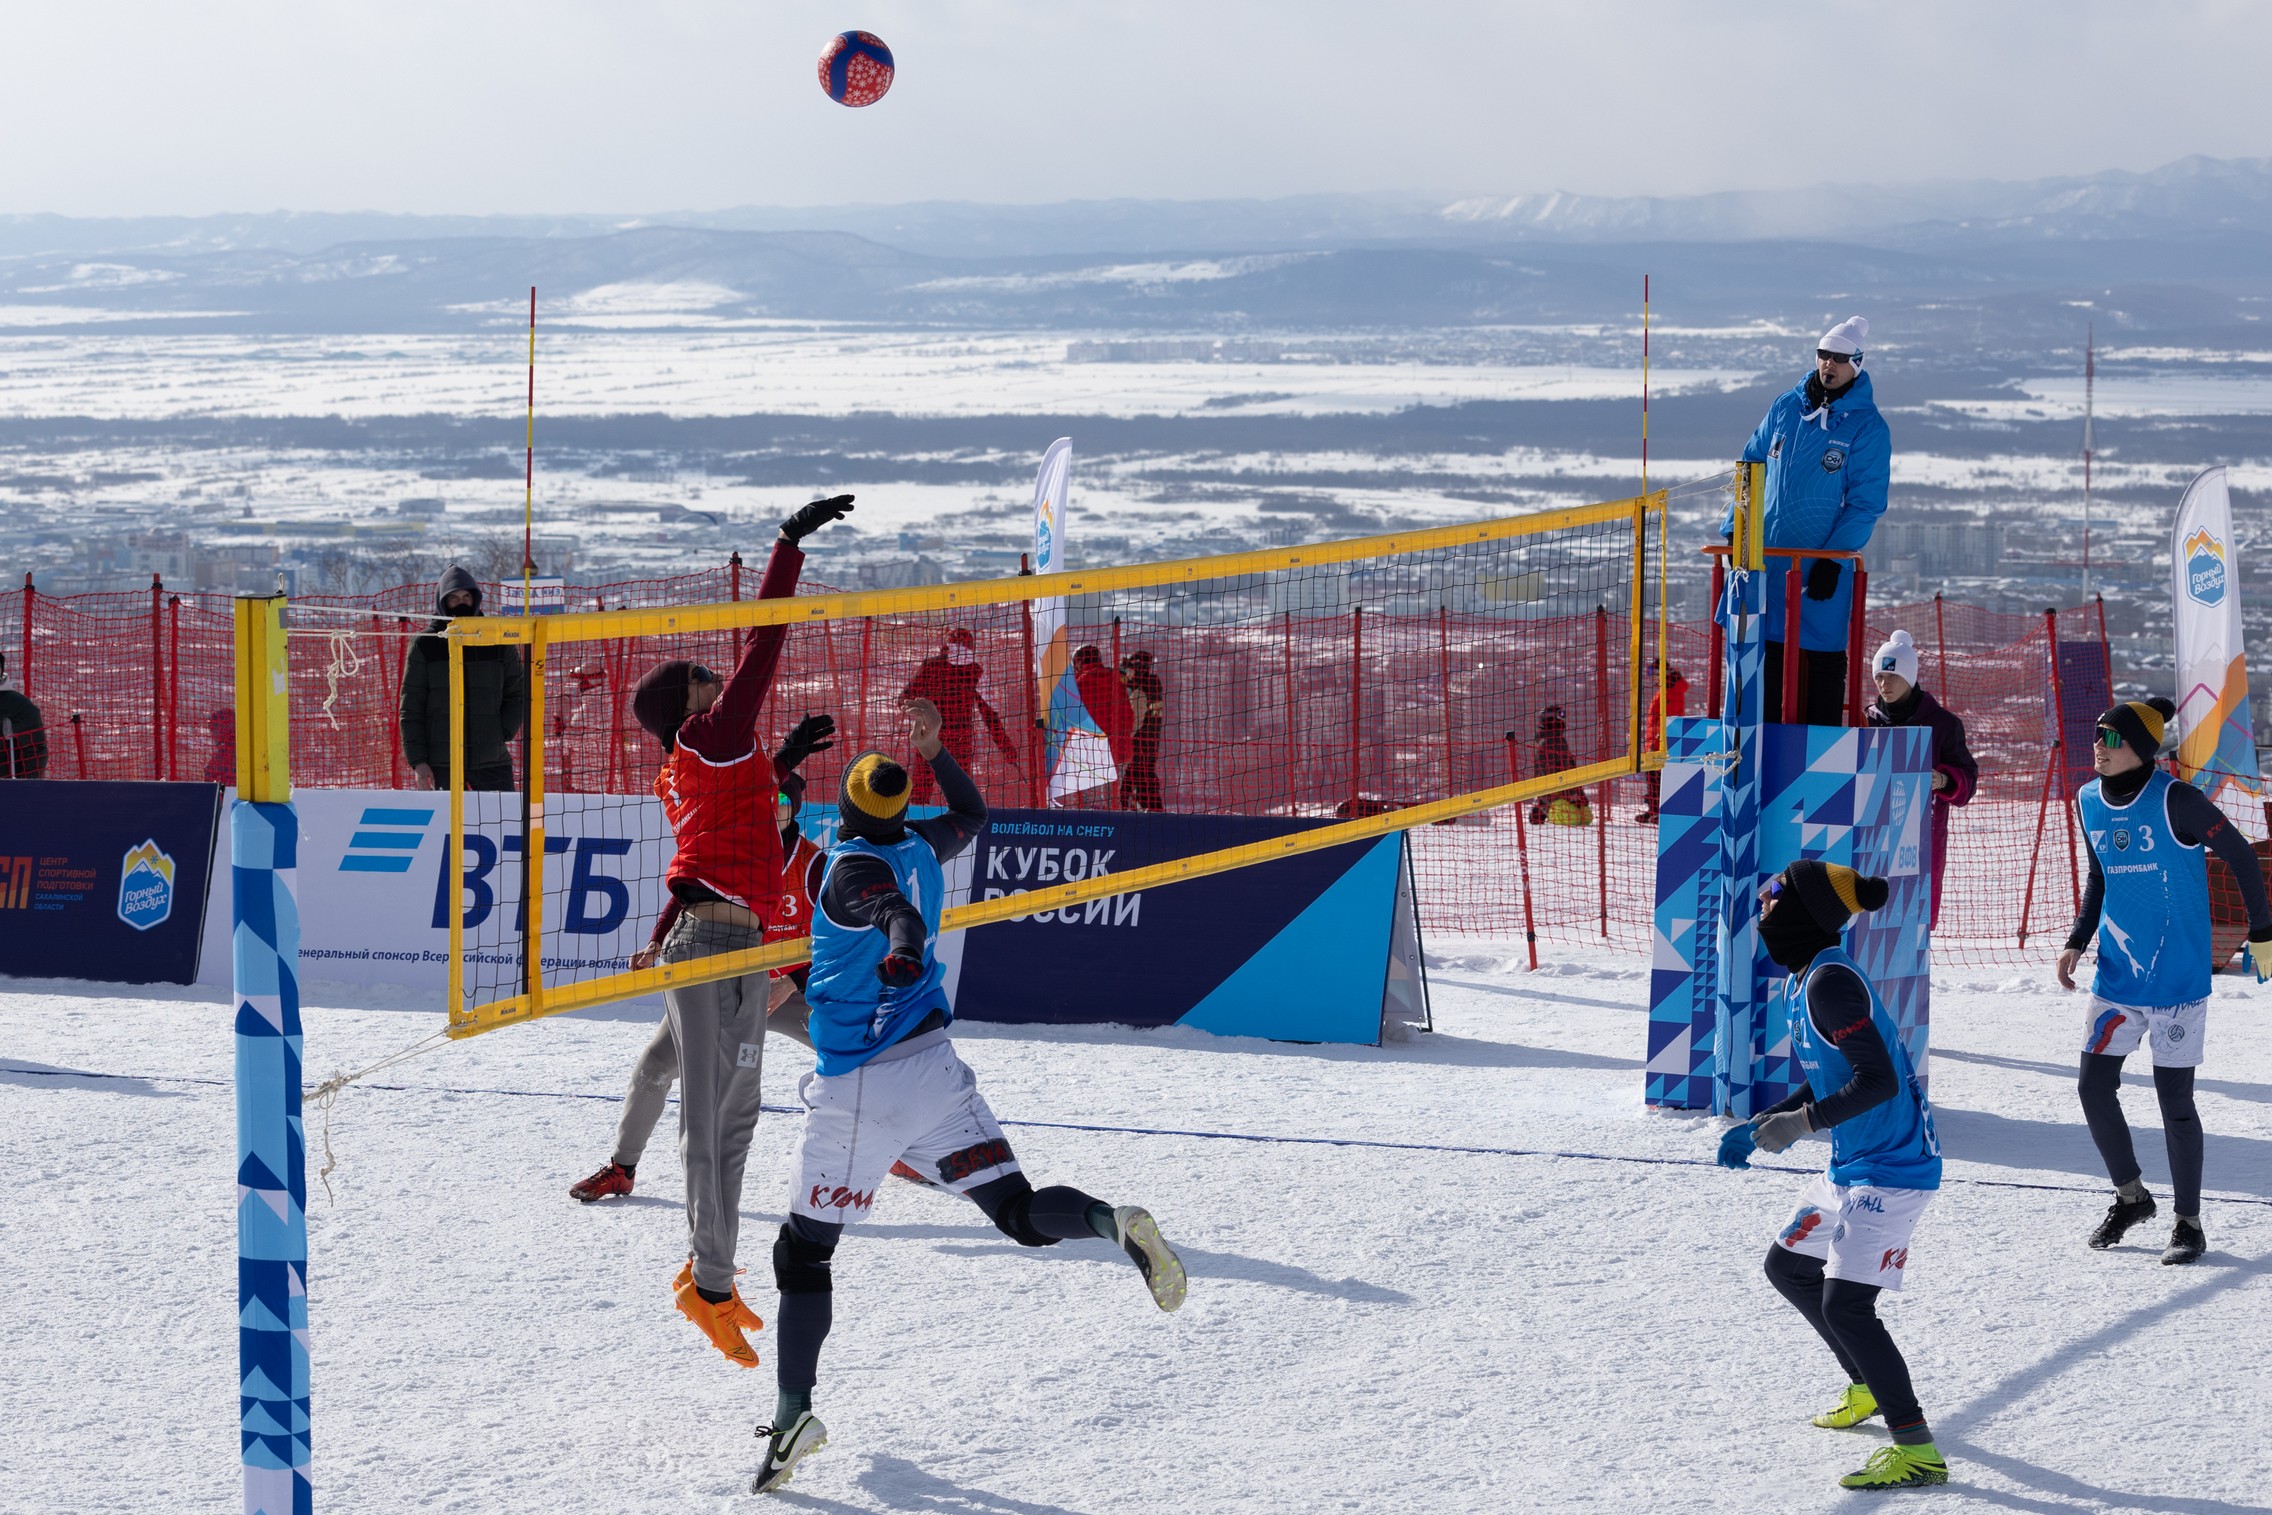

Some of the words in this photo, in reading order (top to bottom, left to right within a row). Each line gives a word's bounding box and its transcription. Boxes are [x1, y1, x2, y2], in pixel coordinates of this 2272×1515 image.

[991, 822, 1054, 836] ВОЛЕЙБОЛ
[1057, 825, 1073, 836] НА
[1076, 825, 1115, 838] СНЕГУ
[2138, 825, 2155, 852] 3
[39, 857, 68, 866] ЦЕНТР
[986, 846, 1116, 882] КУБОК
[2107, 862, 2159, 875] ГАЗПРОМБАНК
[38, 868, 96, 878] СПОРТИВНОЙ
[36, 881, 94, 891] ПОДГОТОВКИ
[125, 881, 164, 903] Горный
[431, 833, 634, 935] ВТБ
[906, 867, 922, 915] 1
[35, 893, 83, 901] САХАЛИНСКОЙ
[782, 894, 798, 917] 3
[372, 951, 420, 963] спонсор
[422, 949, 514, 965] Всерсийской
